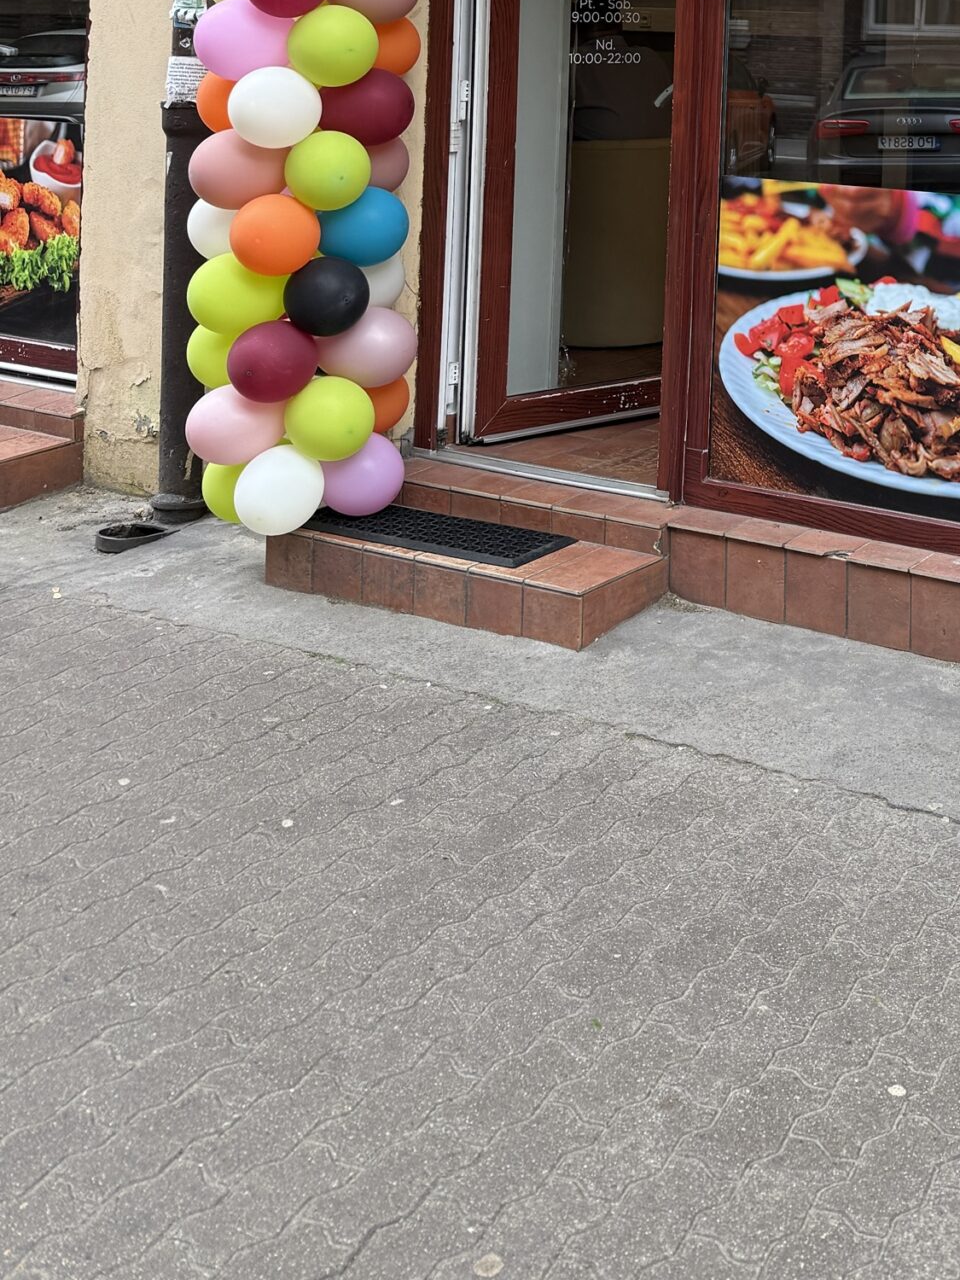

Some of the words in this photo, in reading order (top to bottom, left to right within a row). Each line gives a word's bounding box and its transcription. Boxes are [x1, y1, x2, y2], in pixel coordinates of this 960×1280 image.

[571, 11, 641, 23] 9:00-00:30
[595, 39, 616, 51] Nd.
[568, 52, 641, 65] 10:00-22:00
